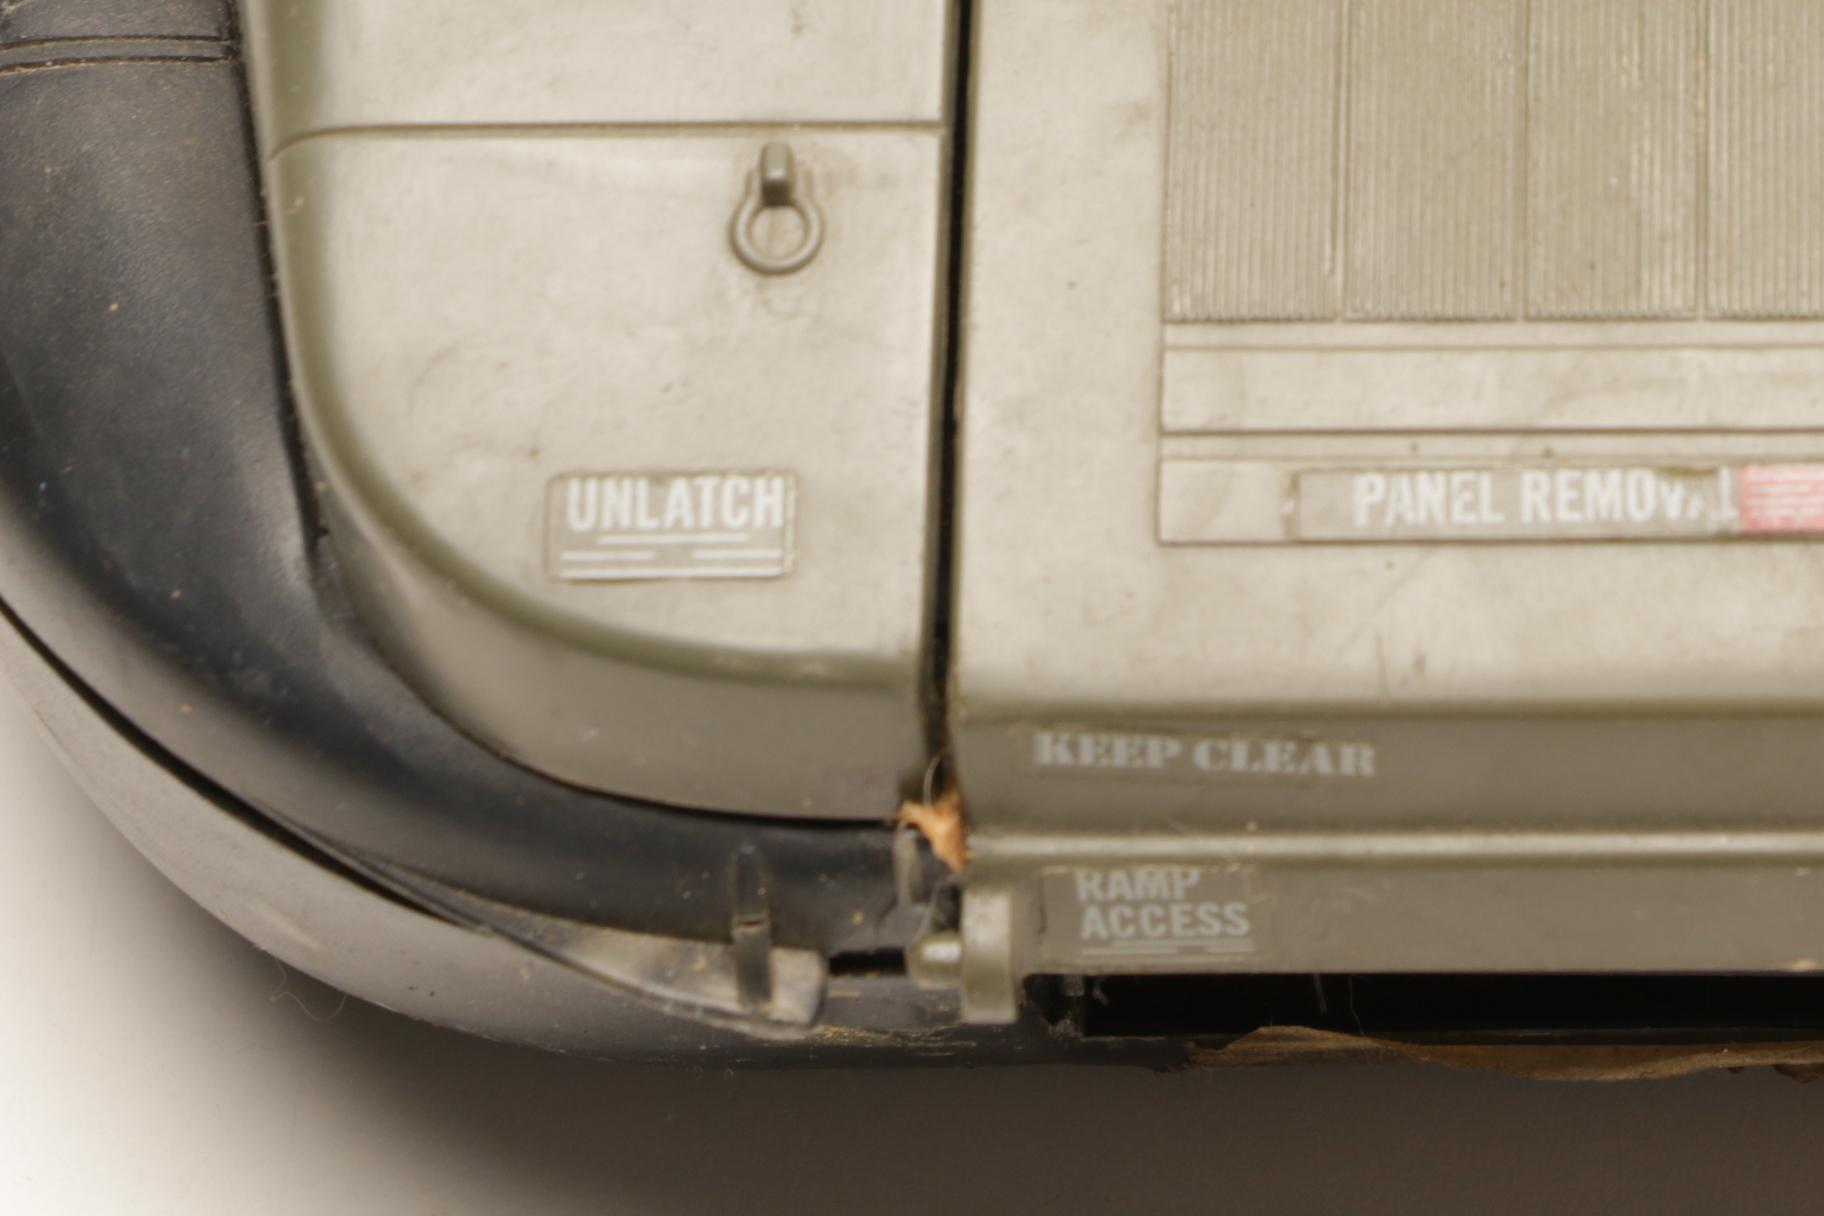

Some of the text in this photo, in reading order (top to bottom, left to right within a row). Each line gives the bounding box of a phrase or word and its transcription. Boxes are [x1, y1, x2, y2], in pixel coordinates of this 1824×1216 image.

[566, 475, 785, 532] UNLATCH
[1354, 470, 1505, 528] PANEL
[1034, 730, 1376, 777] KEEP CLEAR
[1075, 866, 1201, 902] RAMP
[1080, 902, 1251, 940] ACCESS
